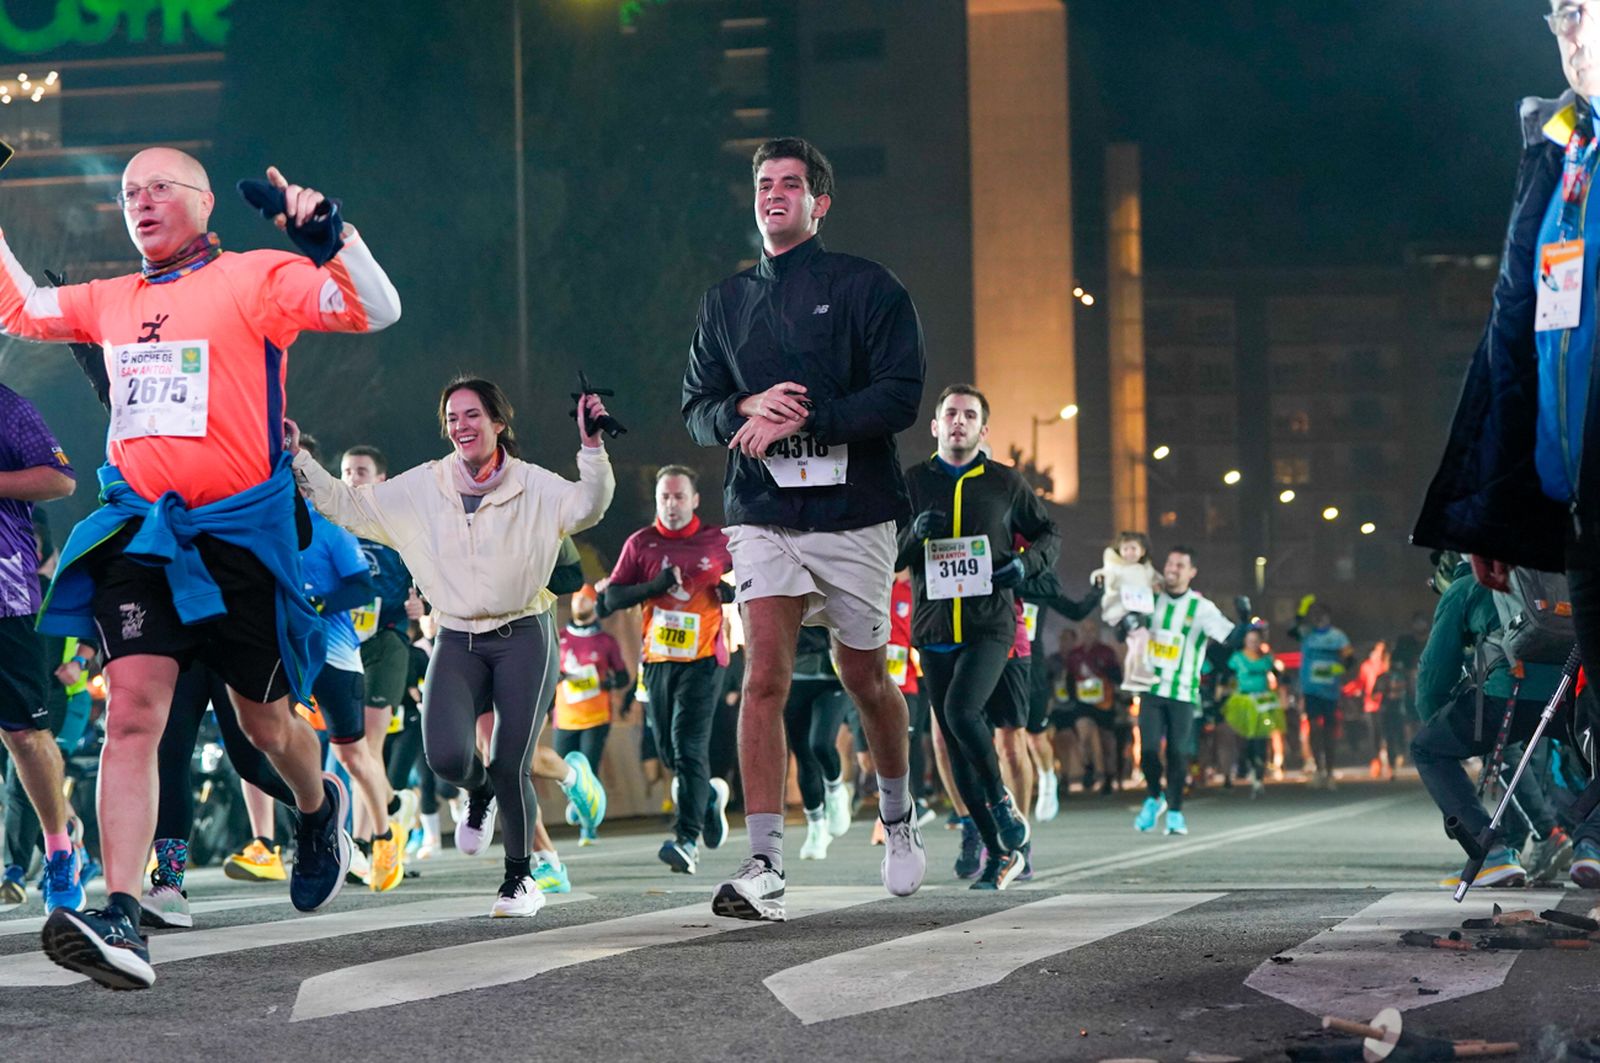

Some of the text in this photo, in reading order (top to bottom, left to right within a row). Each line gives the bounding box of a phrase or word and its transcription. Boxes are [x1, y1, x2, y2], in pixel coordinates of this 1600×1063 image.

[131, 353, 173, 364] NOCHE DE
[121, 366, 139, 378] SAN
[127, 376, 187, 406] 2675
[939, 558, 979, 578] 3149
[740, 578, 753, 592] NIKE
[658, 626, 686, 645] 3778
